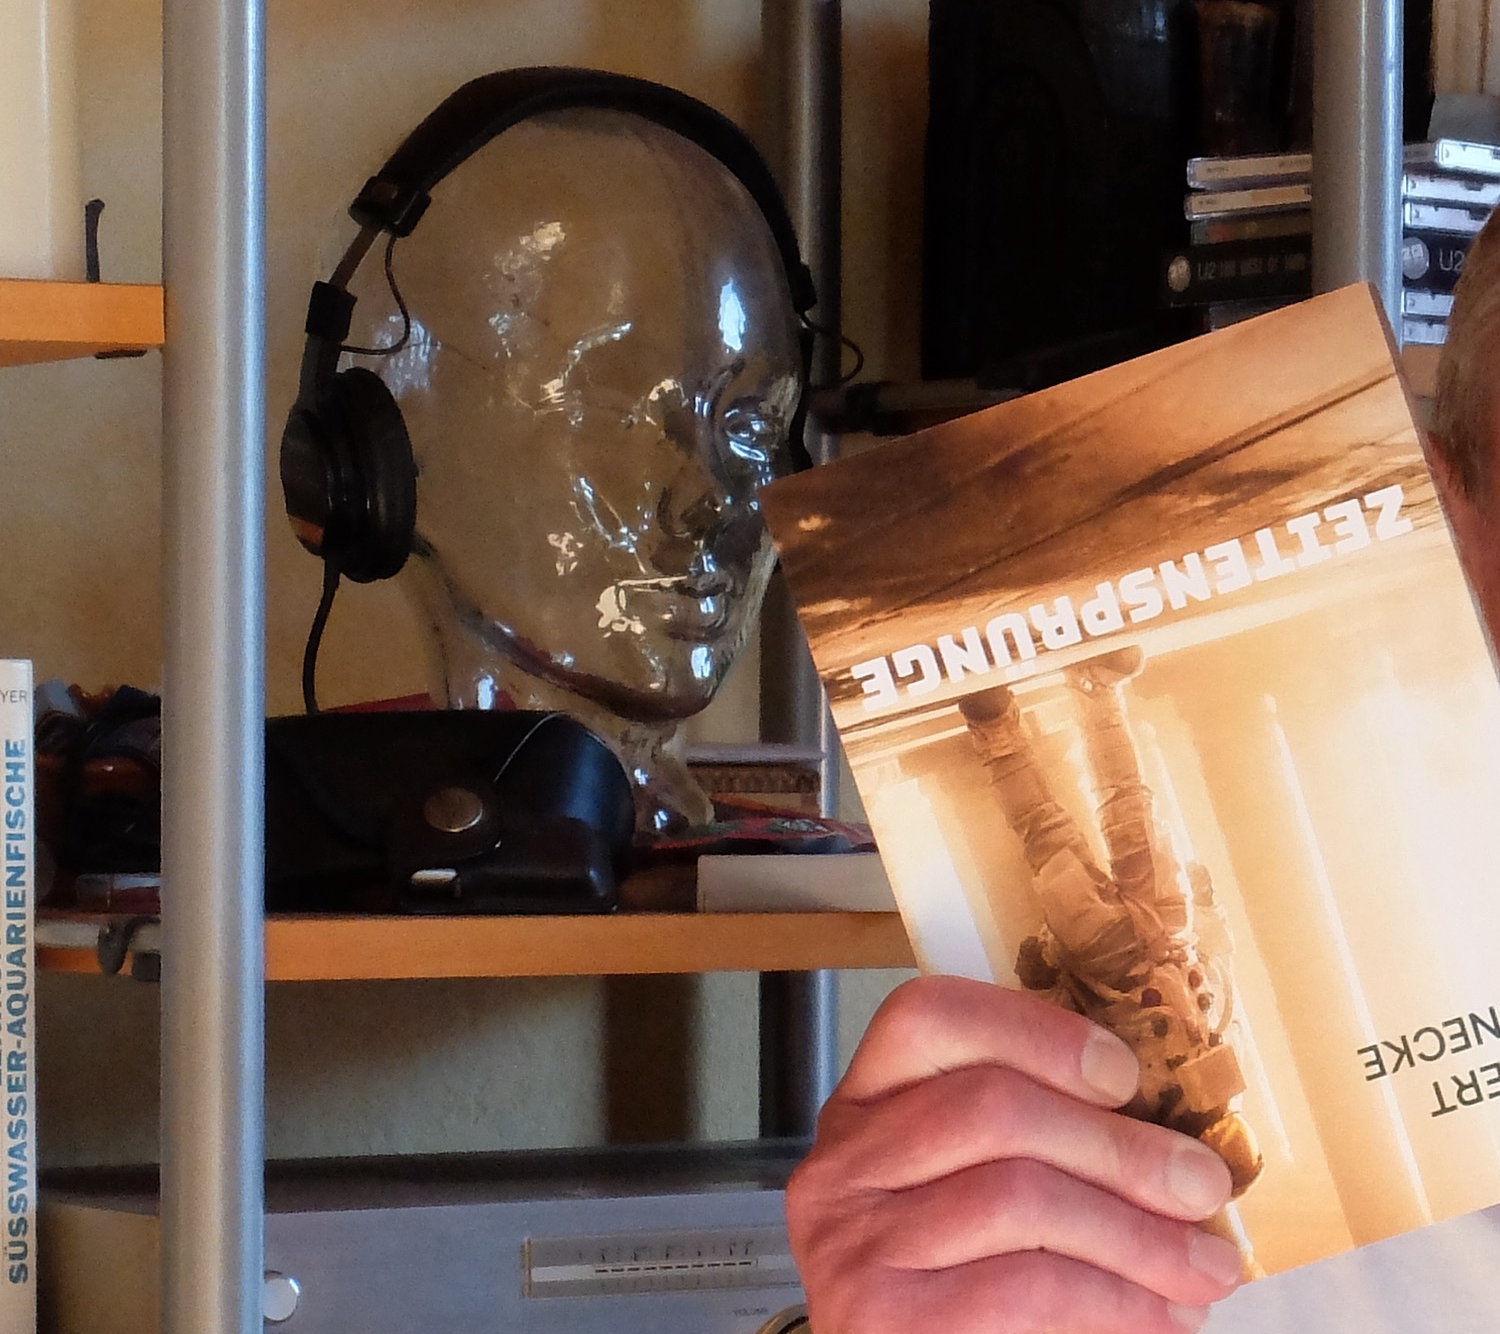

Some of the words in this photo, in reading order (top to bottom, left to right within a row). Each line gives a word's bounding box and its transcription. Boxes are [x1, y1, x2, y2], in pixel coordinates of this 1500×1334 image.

[1197, 261, 1217, 281] U2
[1438, 248, 1465, 273] U2
[852, 483, 1414, 712] ZEITENSPRÜNGE
[0, 690, 27, 704] YER
[6, 738, 27, 1285] SÜSSWASSER-AQUARIENFISCHE
